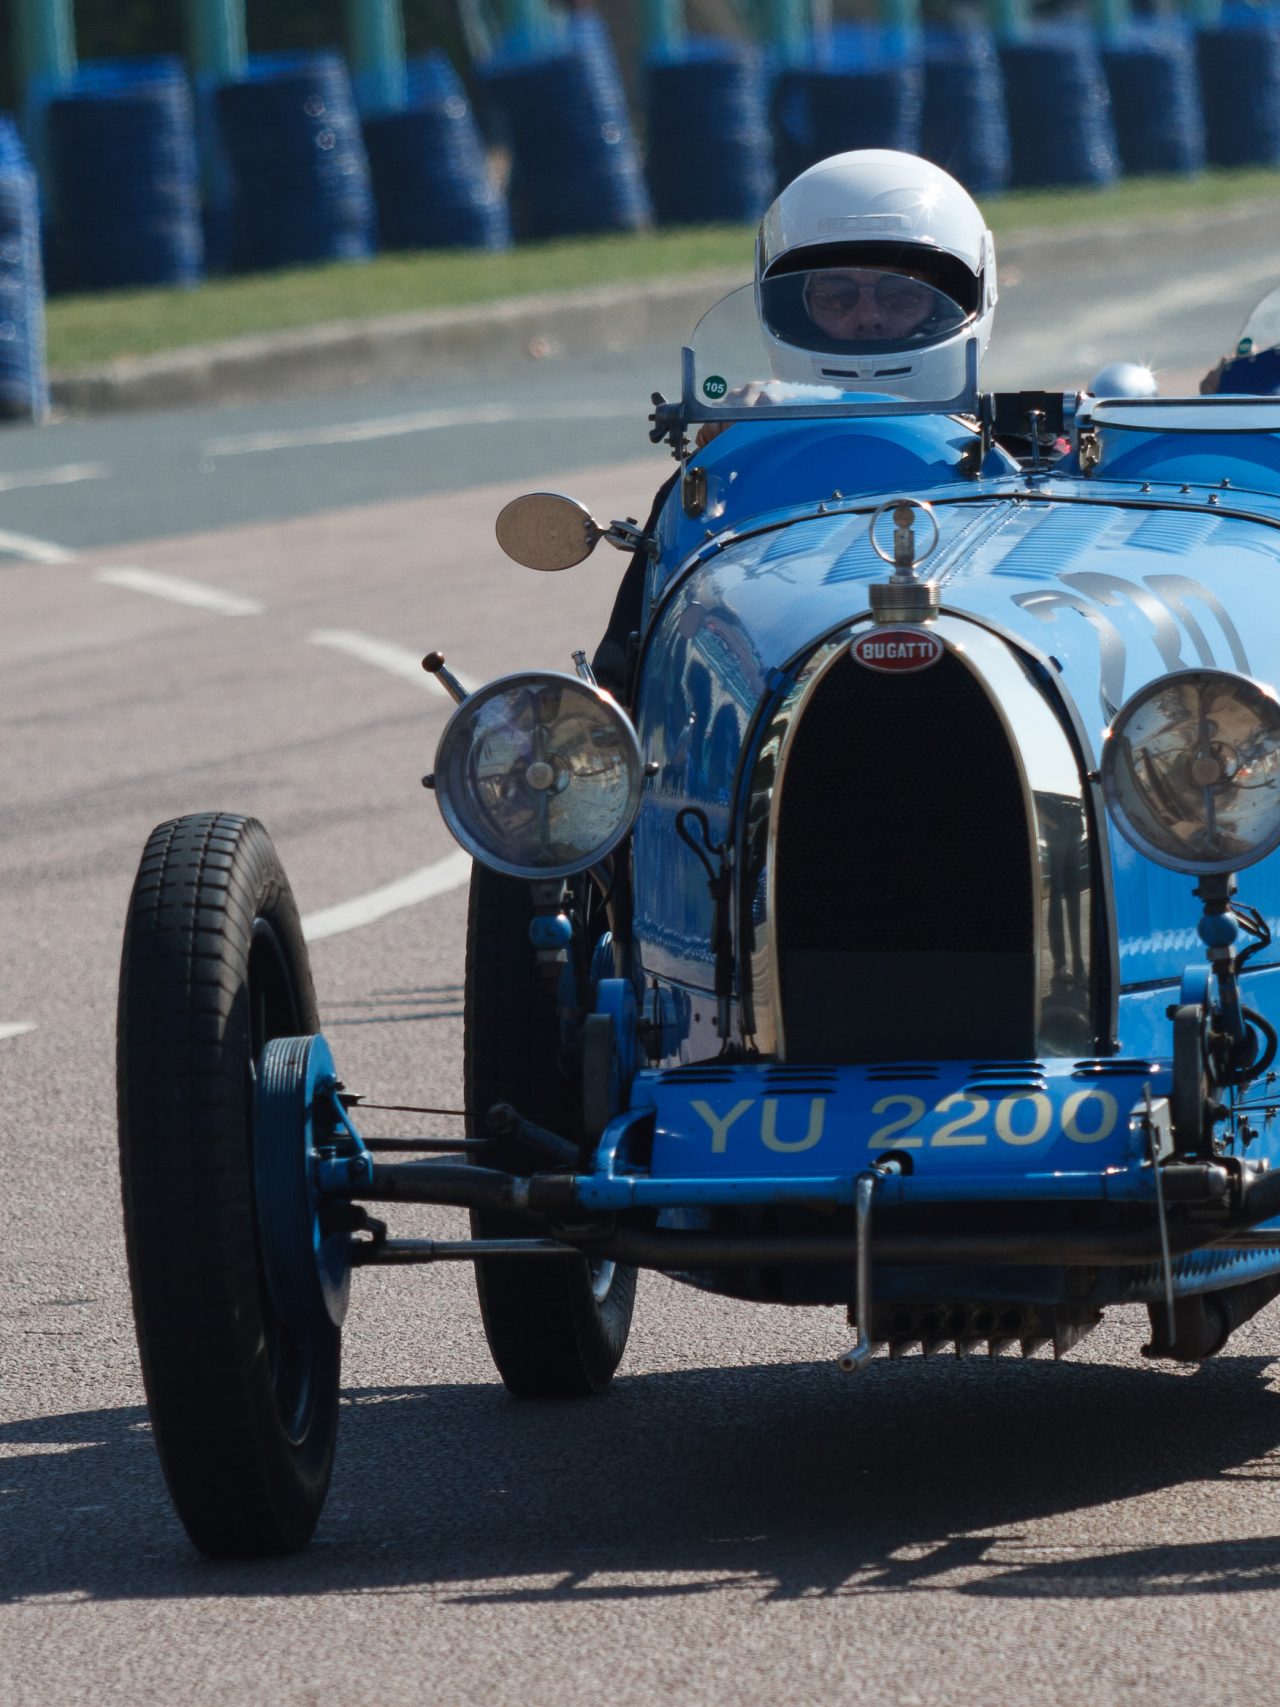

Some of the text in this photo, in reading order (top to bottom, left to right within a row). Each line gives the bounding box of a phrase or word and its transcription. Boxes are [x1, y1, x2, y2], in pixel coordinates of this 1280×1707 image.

[705, 382, 725, 394] 105
[862, 642, 934, 660] BUGATTI
[689, 1088, 1119, 1154] YU 2200
